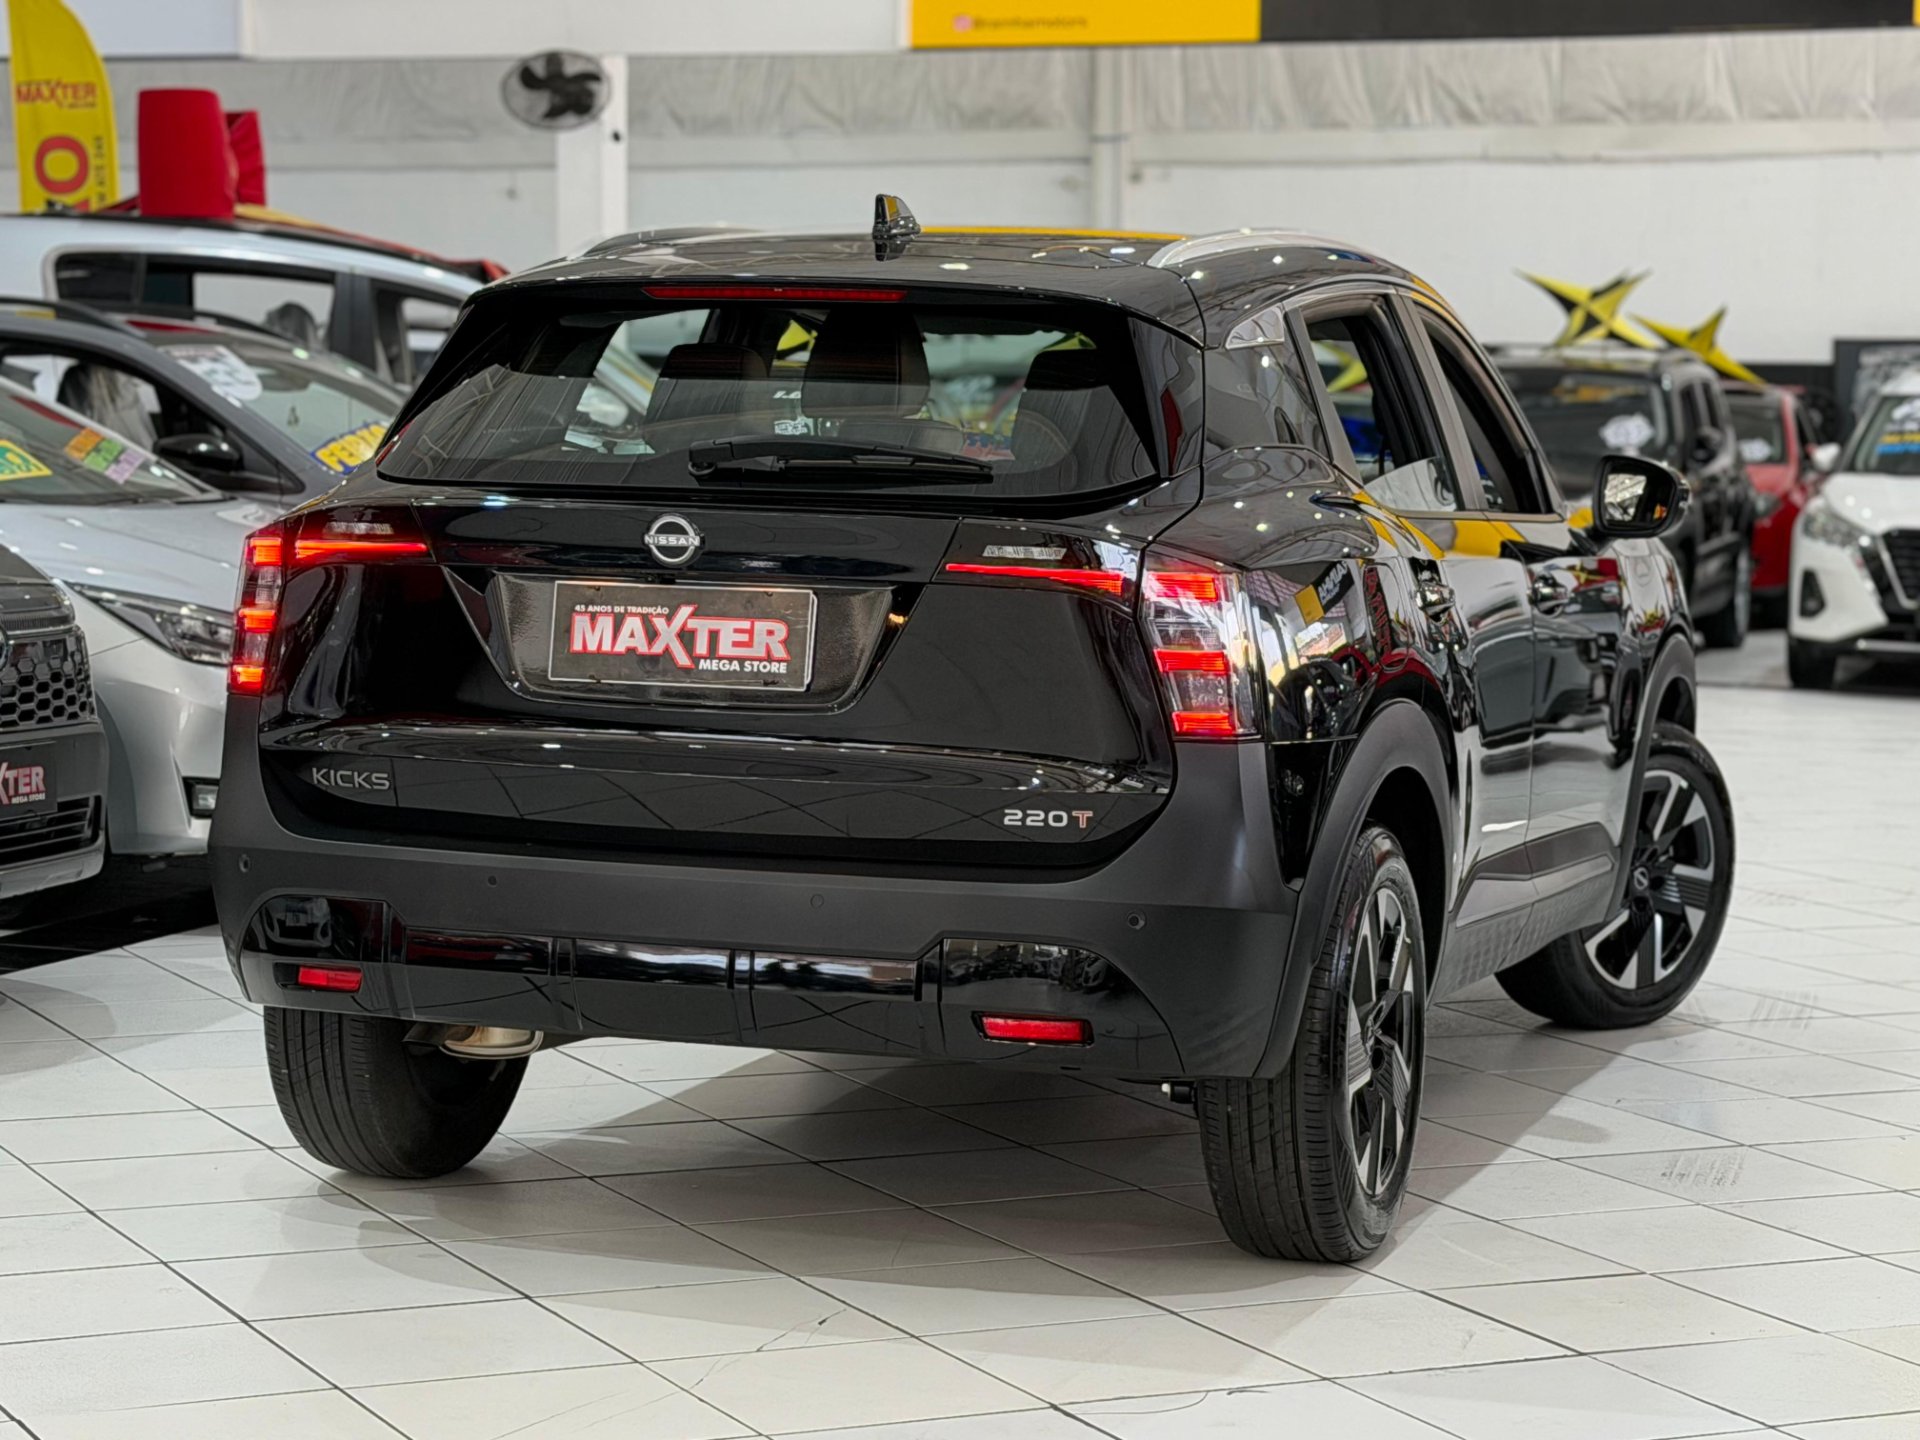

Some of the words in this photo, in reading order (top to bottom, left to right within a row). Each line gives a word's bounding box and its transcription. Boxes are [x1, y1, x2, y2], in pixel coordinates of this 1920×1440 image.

[16, 78, 97, 109] MAXTER
[644, 534, 701, 547] NISSAN
[574, 604, 587, 612] 45
[587, 604, 612, 613] ANOS
[614, 605, 626, 613] DE
[627, 604, 670, 616] TRADIÇÃO
[570, 604, 792, 670] MAXTER
[698, 658, 741, 672] MEGA
[743, 660, 788, 674] STORE
[311, 767, 390, 790] KICKS
[1003, 808, 1094, 829] 220T
